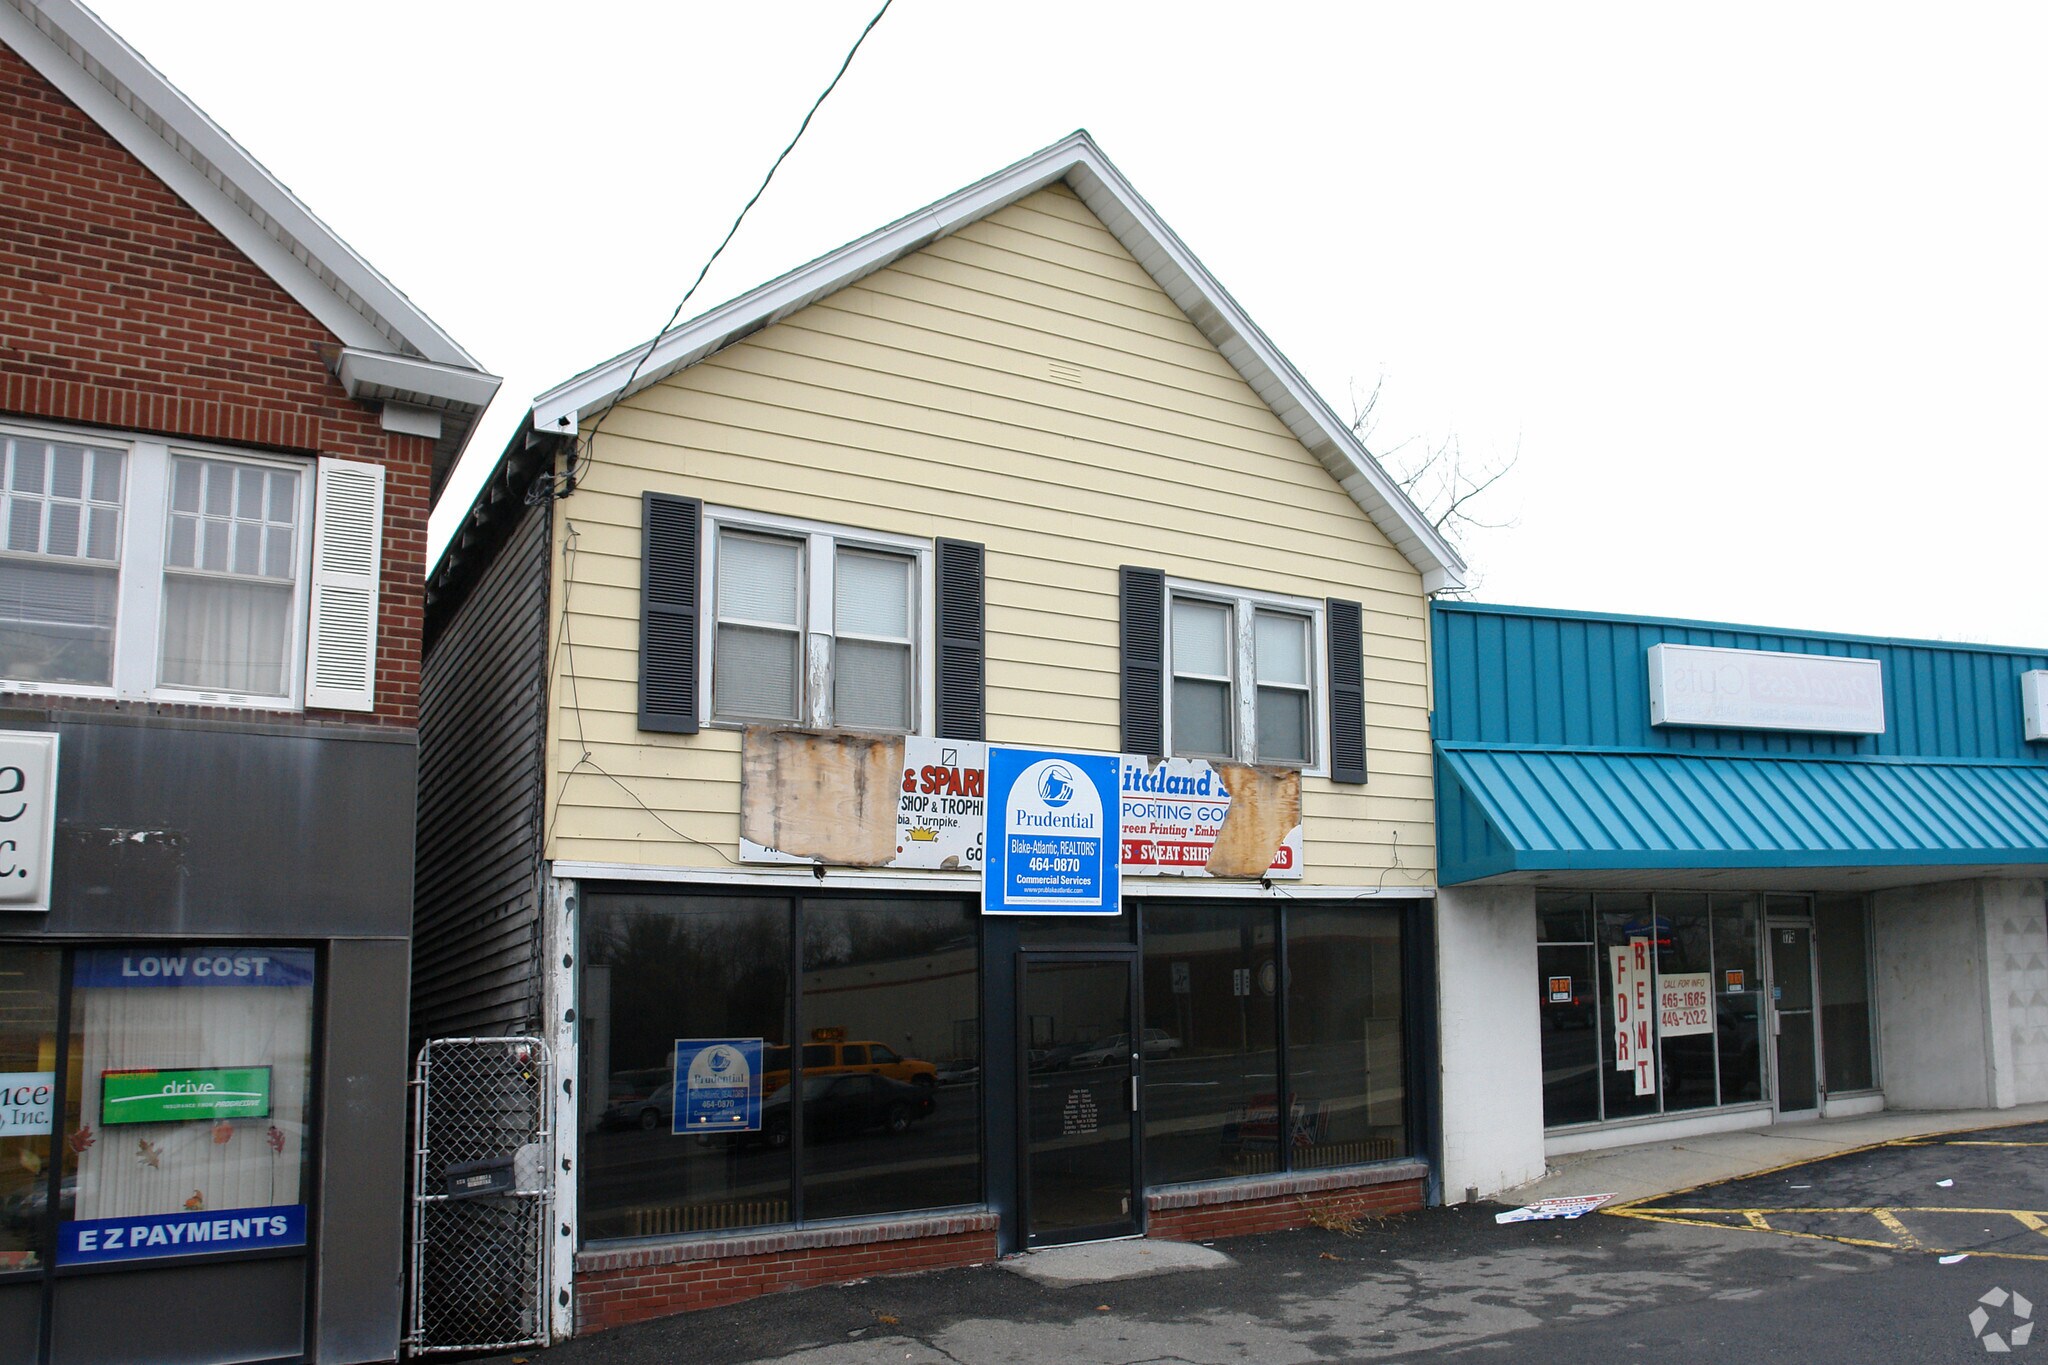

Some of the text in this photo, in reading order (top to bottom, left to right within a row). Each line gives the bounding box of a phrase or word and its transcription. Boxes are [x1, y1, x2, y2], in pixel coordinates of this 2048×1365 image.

[902, 768, 918, 793] &
[901, 795, 929, 812] SHOP
[931, 801, 938, 813] &
[1122, 803, 1192, 820] PORTING
[915, 815, 961, 829] Turnpike.
[1016, 809, 1094, 829] Prudential
[1149, 822, 1188, 838] Printing
[1011, 839, 1060, 856] Blake-Atlantic,
[1141, 844, 1181, 860] SWEAT
[1029, 857, 1080, 872] 464-0870
[1016, 874, 1092, 885] Commercial Services
[122, 956, 269, 977] LOW COST
[1664, 979, 1705, 989] CALL FOR INFO
[1662, 991, 1706, 1008] 465-1685
[1635, 941, 1649, 1089] RENT
[1662, 1009, 1708, 1027] 449-2122
[694, 1073, 744, 1084] Prudential
[162, 1080, 216, 1095] drive
[11, 1109, 49, 1125] Inc.
[78, 1215, 288, 1252] E Z PAYMENTS
